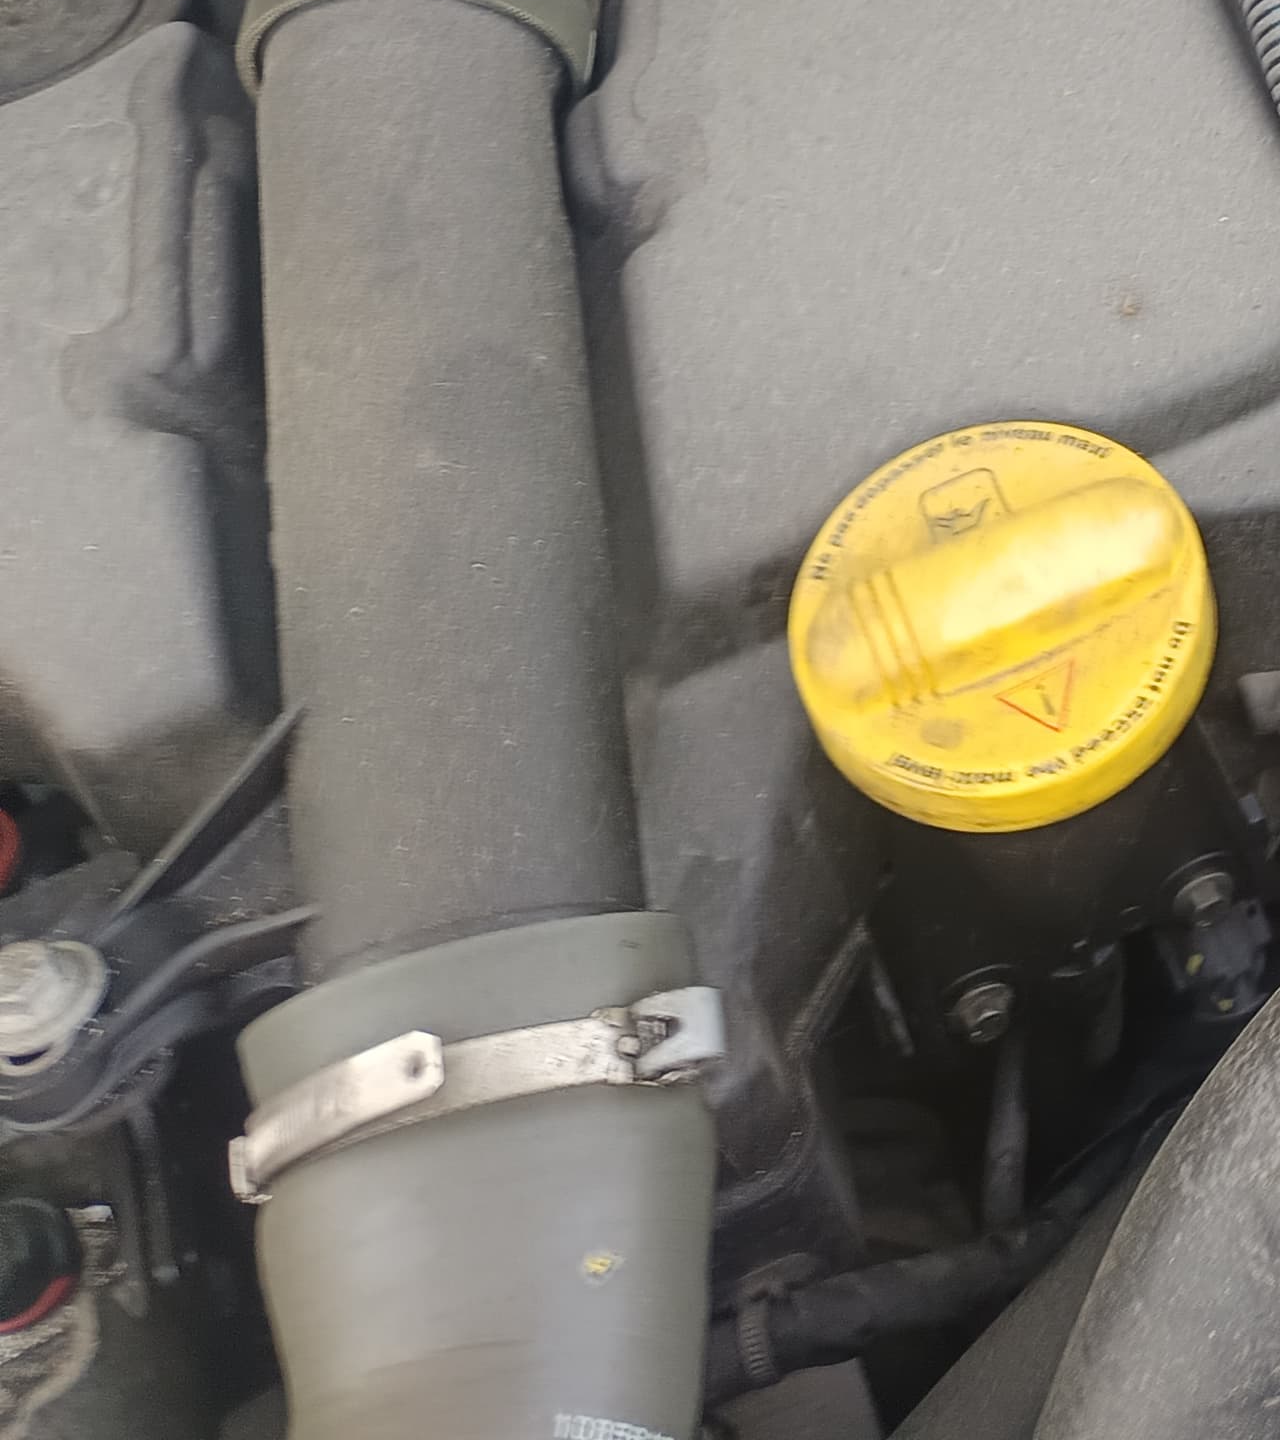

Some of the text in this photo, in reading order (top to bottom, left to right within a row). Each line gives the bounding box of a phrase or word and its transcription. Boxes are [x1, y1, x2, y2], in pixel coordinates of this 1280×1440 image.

[829, 511, 856, 548] pas
[949, 433, 973, 450] le
[980, 427, 1051, 443] niveau
[1153, 654, 1176, 694] not
[1073, 694, 1151, 763] exceed
[1026, 756, 1071, 779] the
